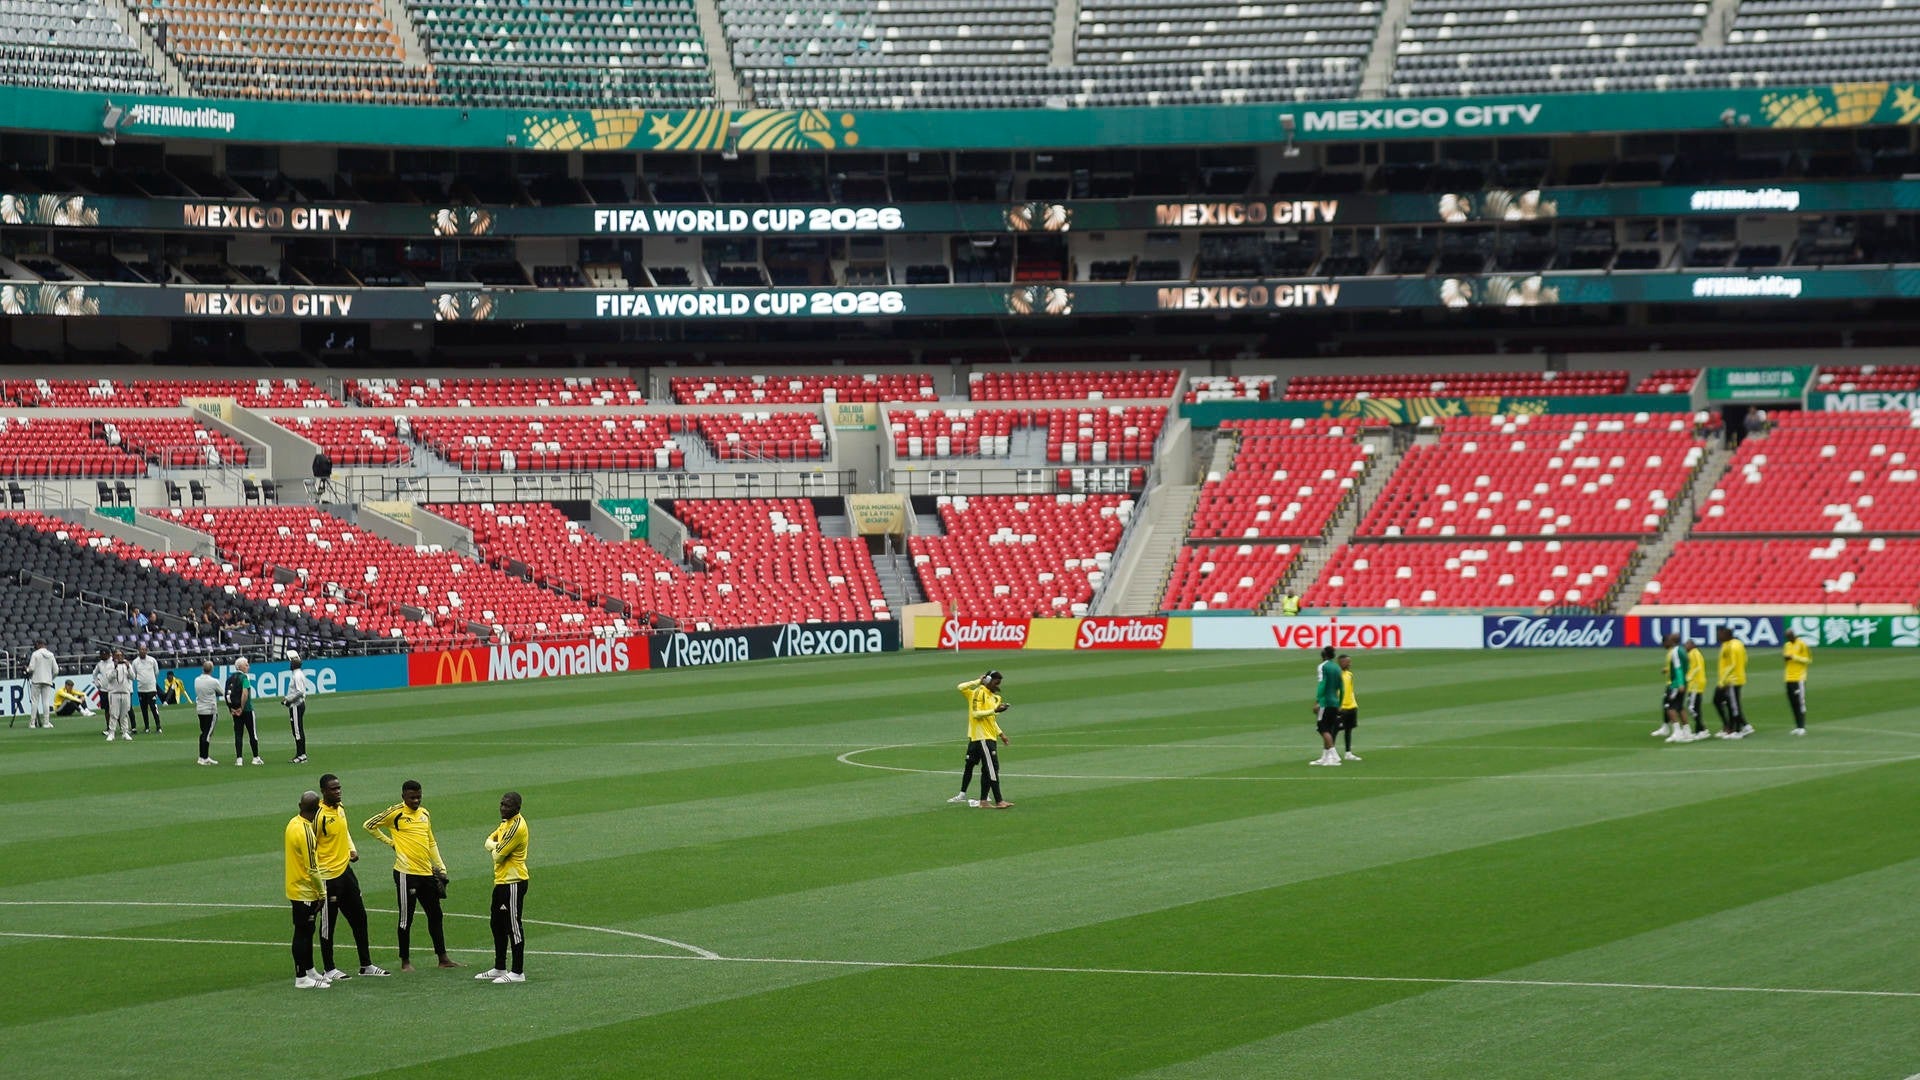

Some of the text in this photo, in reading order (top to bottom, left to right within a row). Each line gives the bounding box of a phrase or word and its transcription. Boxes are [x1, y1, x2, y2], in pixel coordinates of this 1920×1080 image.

[130, 104, 235, 132] #FIFAWorldCup
[1303, 104, 1542, 131] MEXICO CITY
[183, 204, 352, 231] MEXICO CITY
[594, 208, 904, 232] FIFA WORLD CUP 2026
[1155, 200, 1339, 226] MEXICO CITY
[184, 292, 353, 317] MEXICO CITY
[596, 291, 906, 317] FIFA WORLD CUP 2026
[1157, 284, 1340, 310] MEXICO CITY
[839, 404, 864, 413] SALIDA
[1825, 392, 1920, 412] MEXI
[615, 507, 632, 515] FIFA
[630, 514, 646, 522] CUP
[786, 623, 882, 657] Rexona
[942, 619, 1026, 648] Sabritas
[1078, 619, 1164, 648] Sabritas
[1272, 617, 1402, 649] verizon
[1487, 616, 1779, 649] Michelob ULTRA
[488, 637, 629, 681] McDonald's
[675, 633, 749, 667] Rexona
